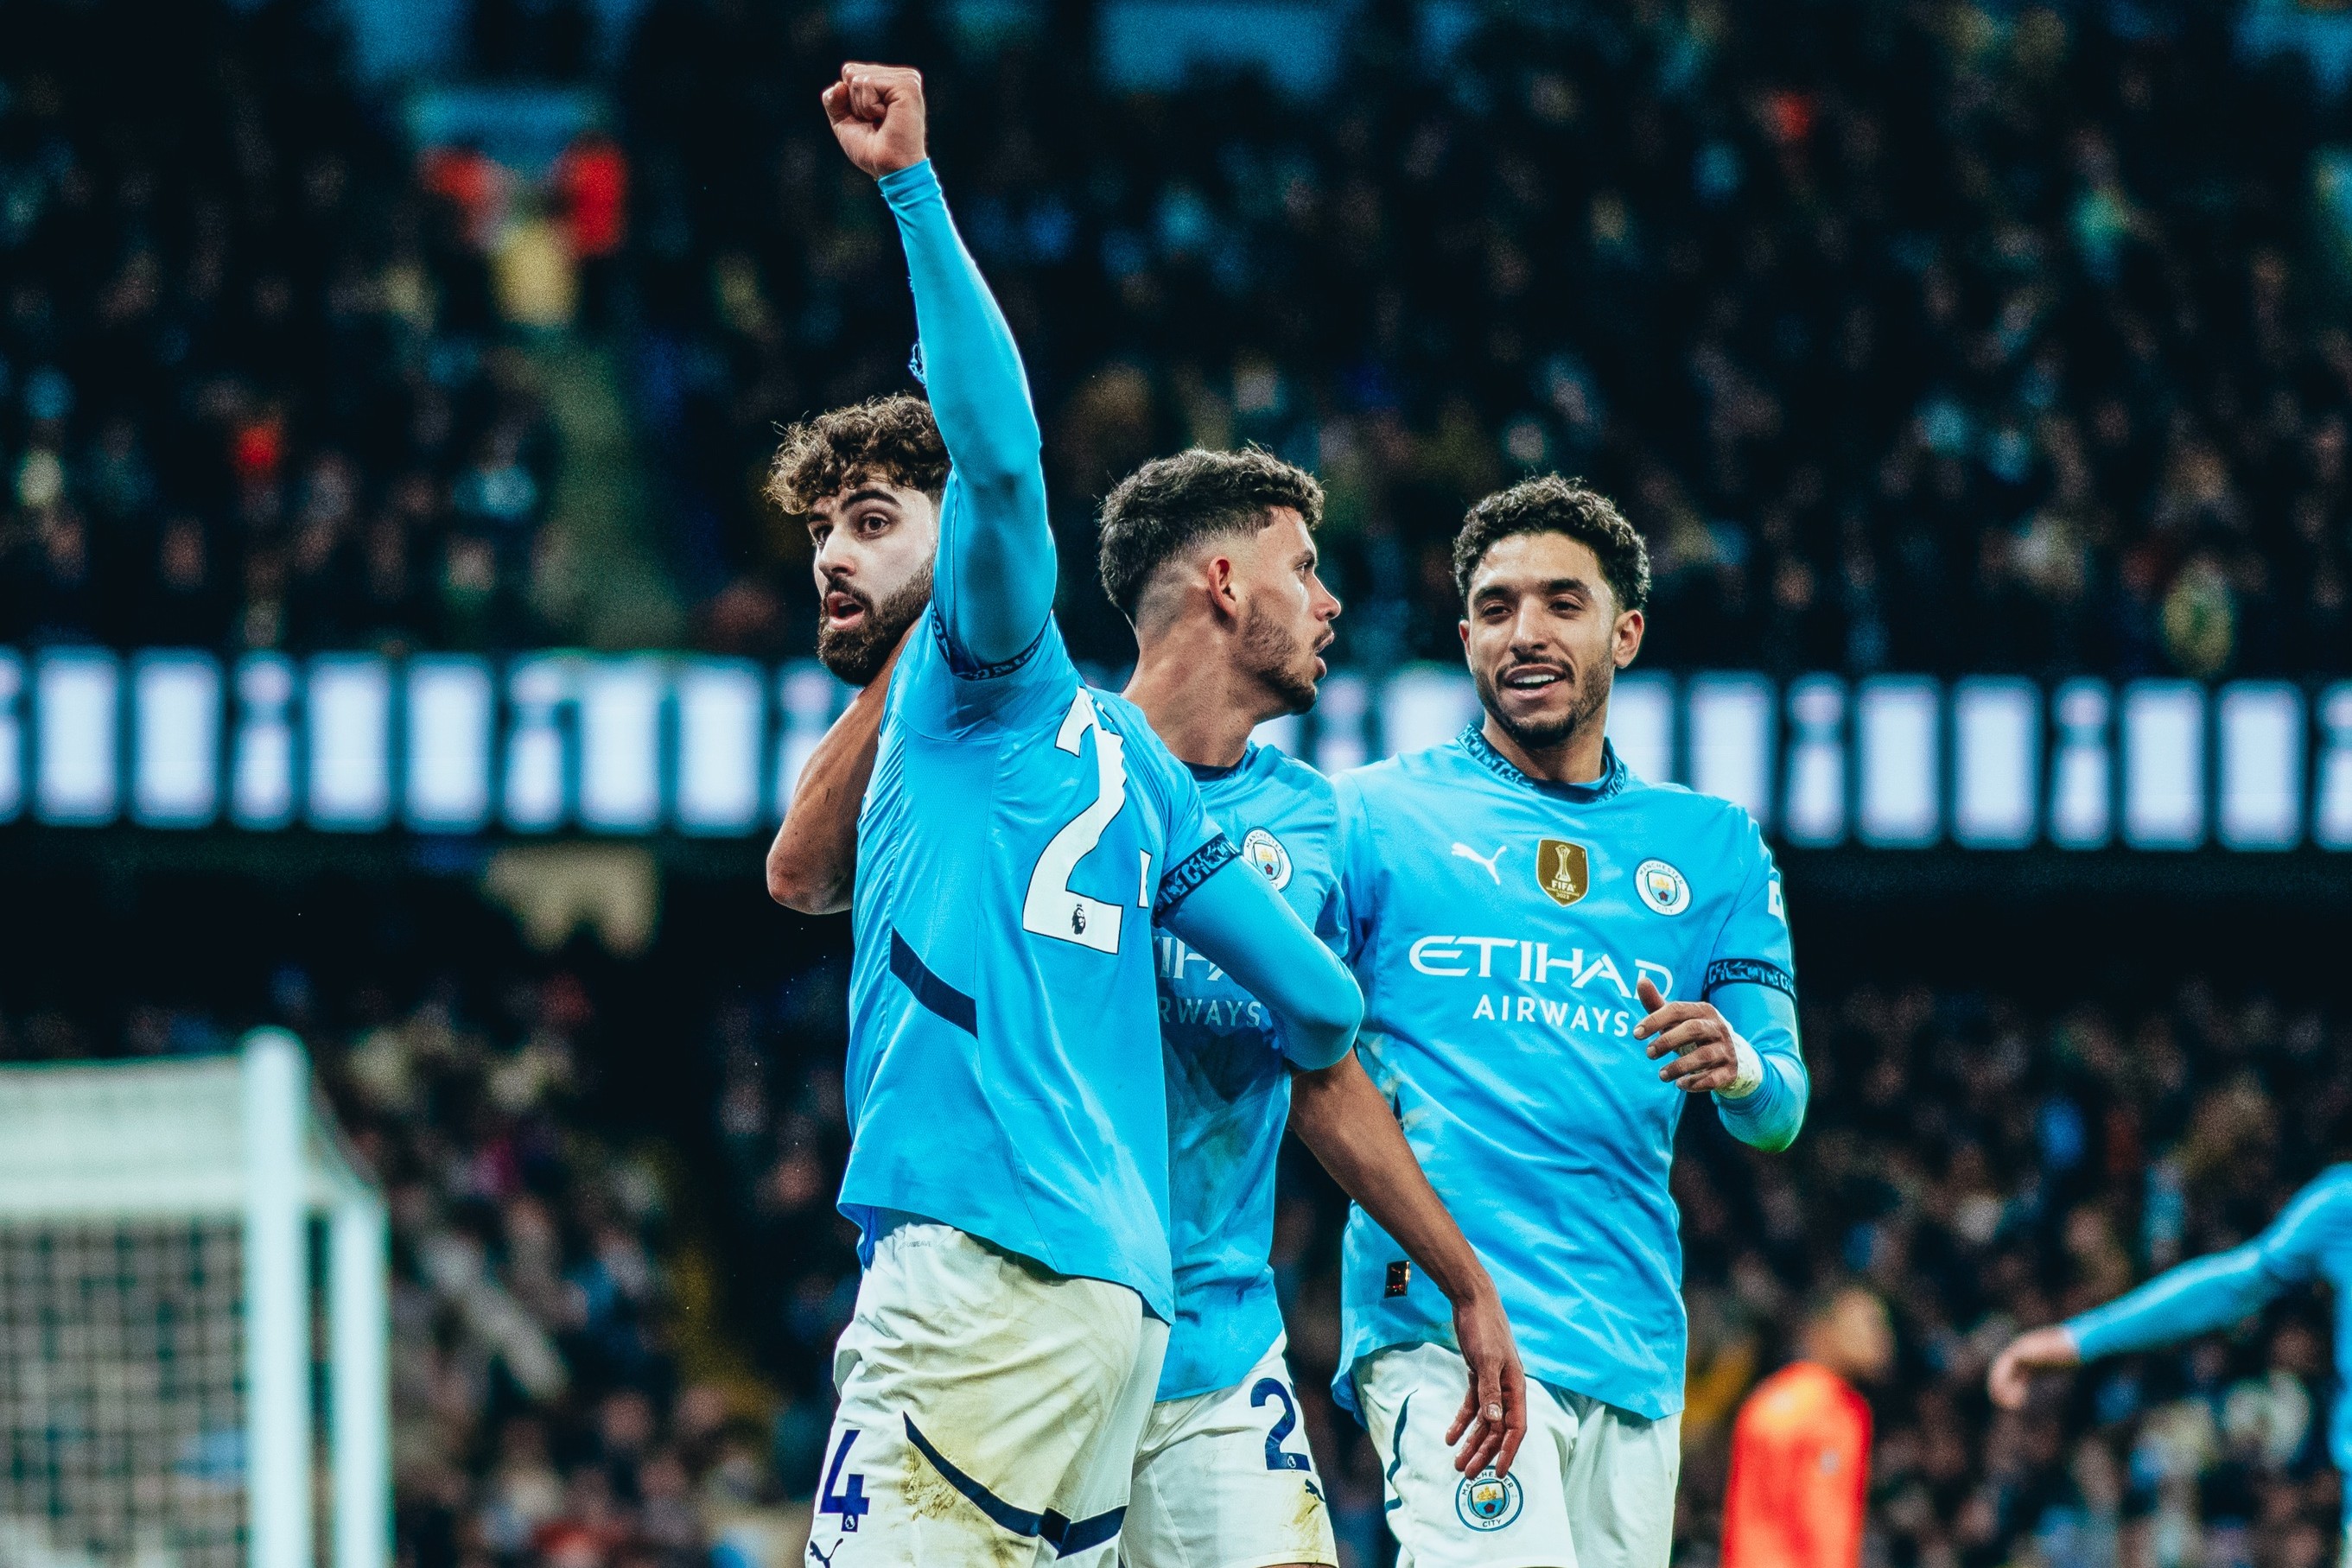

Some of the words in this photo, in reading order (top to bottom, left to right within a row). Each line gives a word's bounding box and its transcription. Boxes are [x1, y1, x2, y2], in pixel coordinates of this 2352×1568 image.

[1023, 686, 1153, 955] 2
[1551, 879, 1575, 892] FIFA
[1640, 863, 1684, 885] MANCHESTER
[1656, 905, 1674, 914] CITY
[1409, 935, 1674, 1000] ETIHAD
[1472, 994, 1630, 1037] AIRWAYS
[1250, 1377, 1312, 1472] 2
[818, 1429, 870, 1533] 4
[1482, 1519, 1502, 1527] CITY
